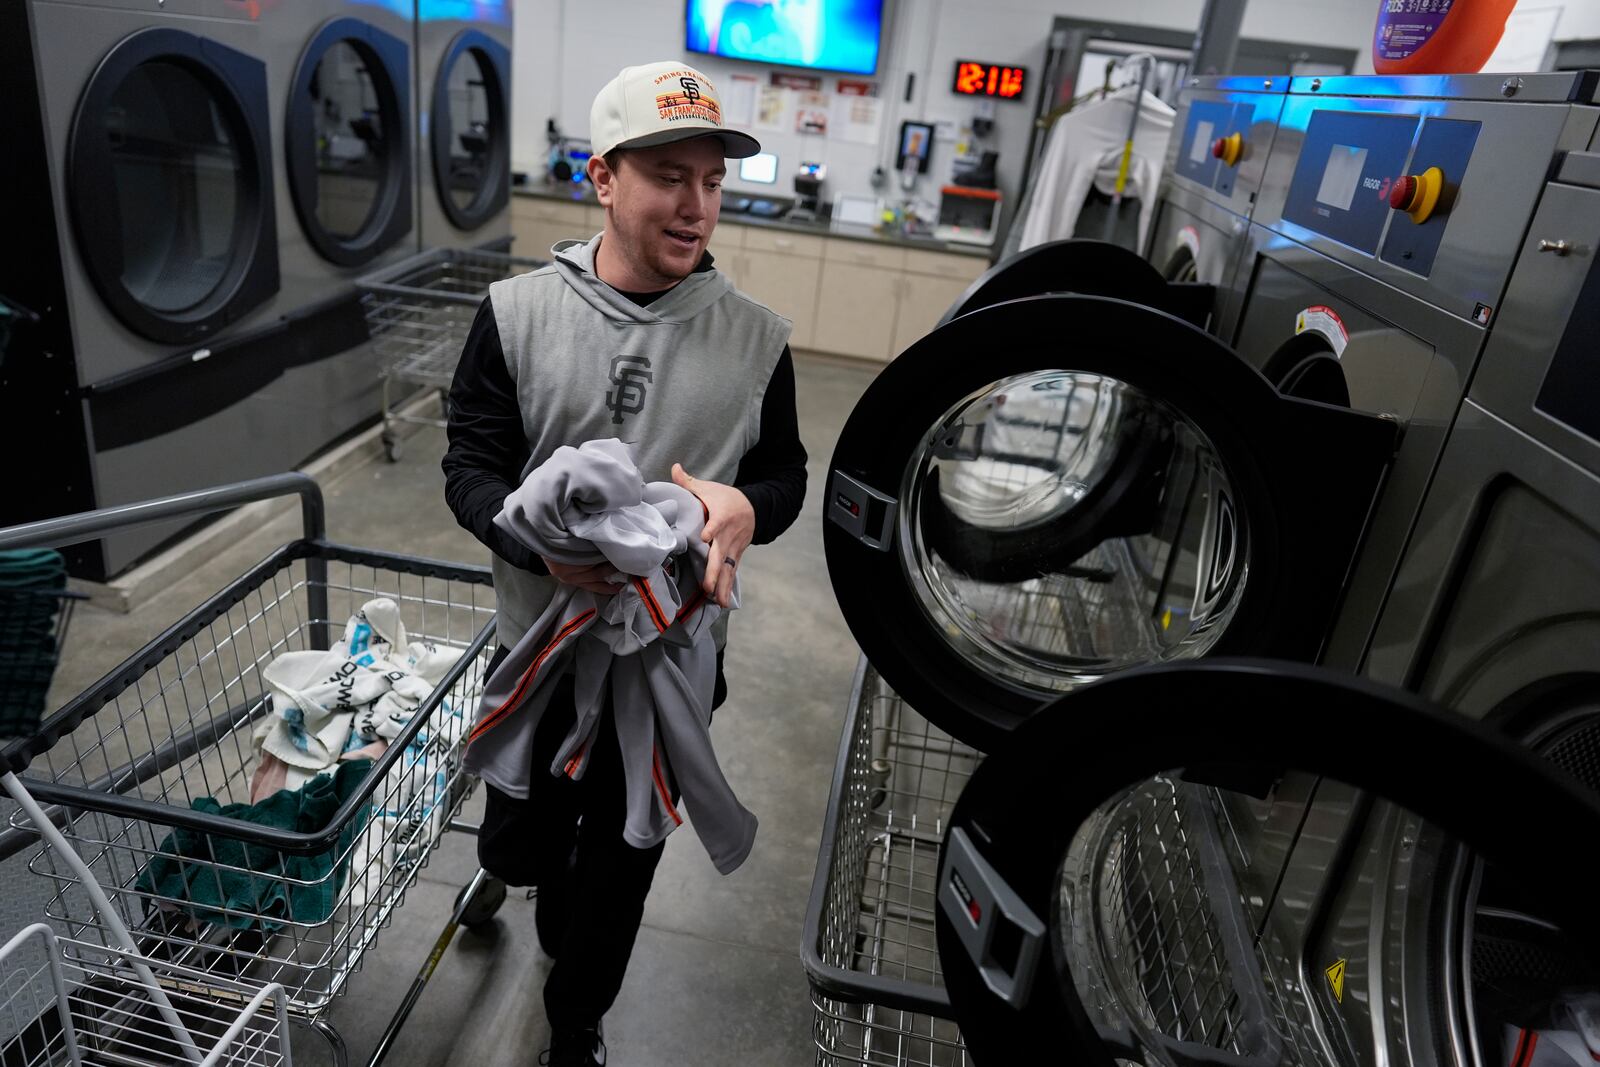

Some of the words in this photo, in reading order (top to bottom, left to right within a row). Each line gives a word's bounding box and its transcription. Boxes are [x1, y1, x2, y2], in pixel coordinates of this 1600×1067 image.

[654, 71, 682, 85] SPRING
[680, 77, 700, 105] SF
[660, 108, 673, 119] SAN
[674, 105, 707, 117] FRANCISCO
[1363, 177, 1381, 190] FAGOR
[606, 354, 653, 424] SF
